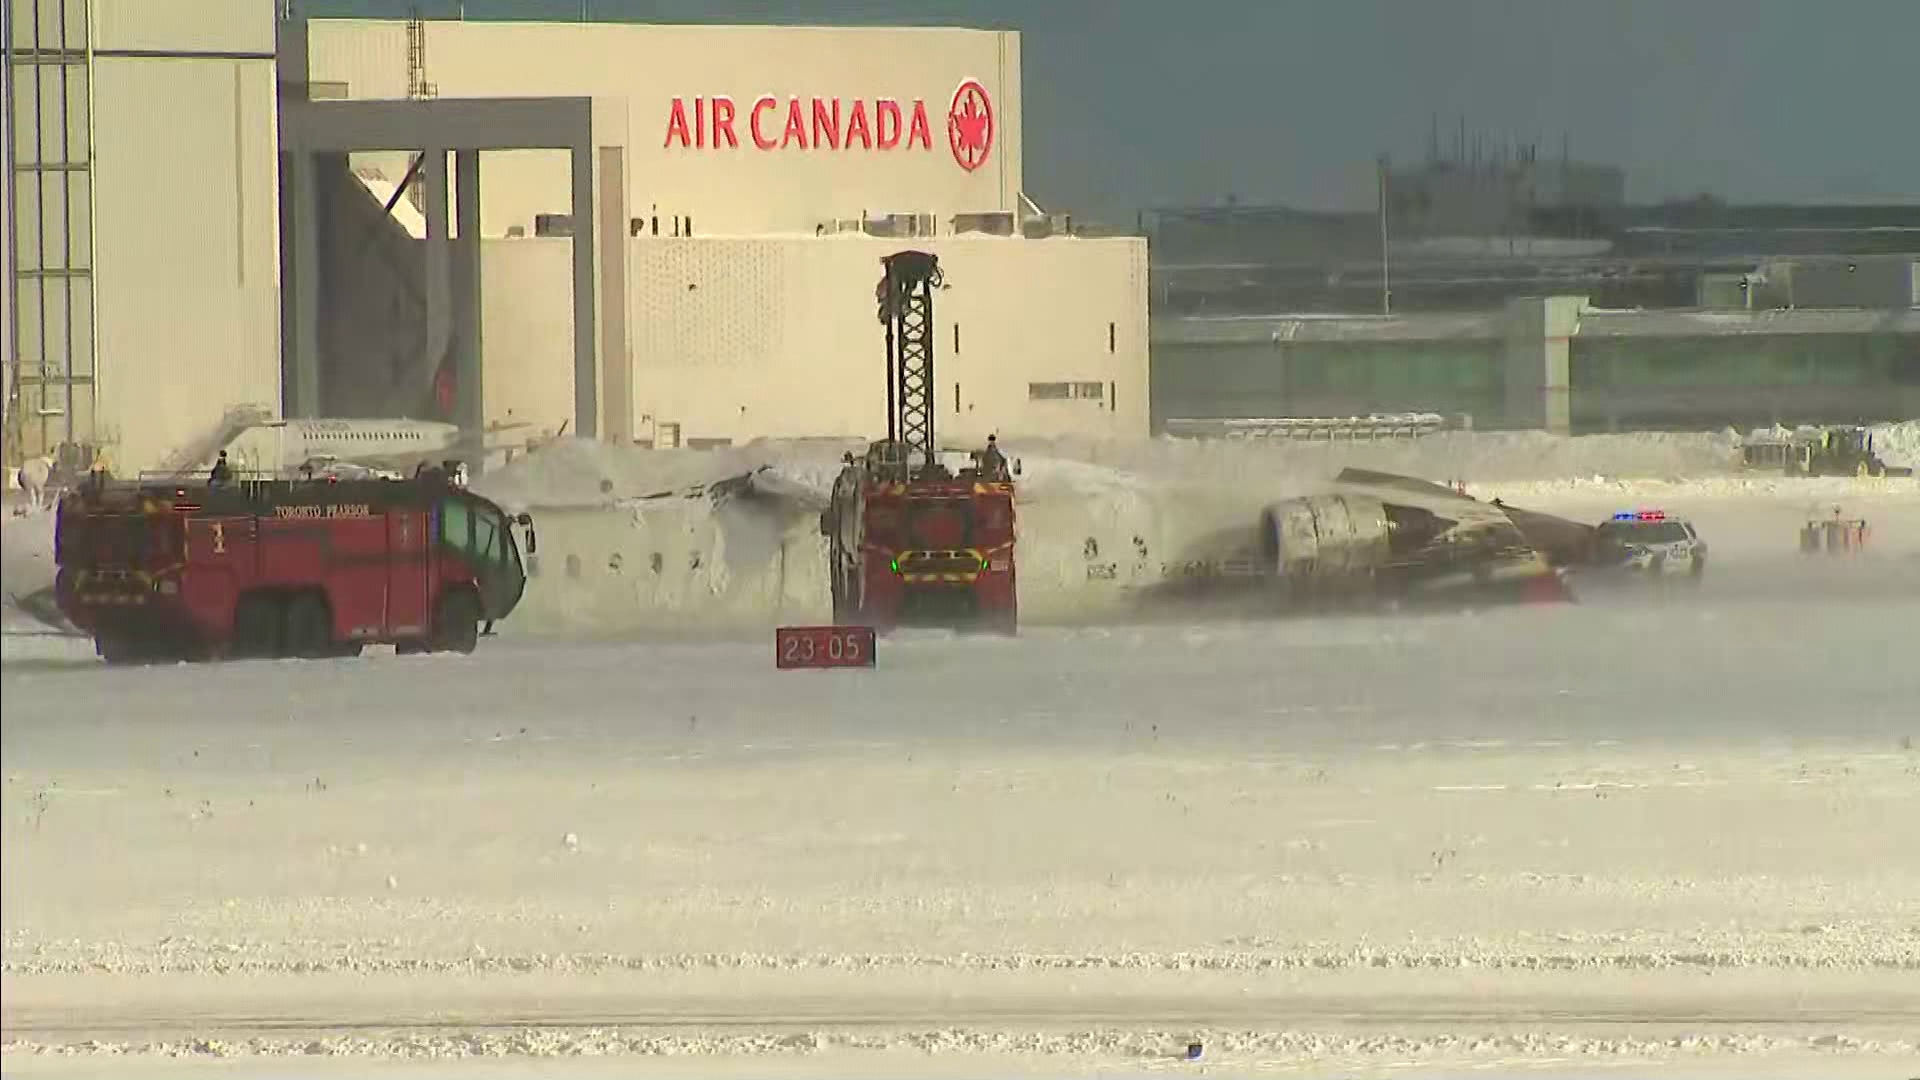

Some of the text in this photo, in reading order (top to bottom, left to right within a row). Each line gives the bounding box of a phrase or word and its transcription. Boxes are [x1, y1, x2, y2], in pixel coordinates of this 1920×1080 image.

[664, 97, 932, 150] AIR CANADA
[275, 505, 320, 520] TORONTO
[784, 634, 859, 661] 23-05
